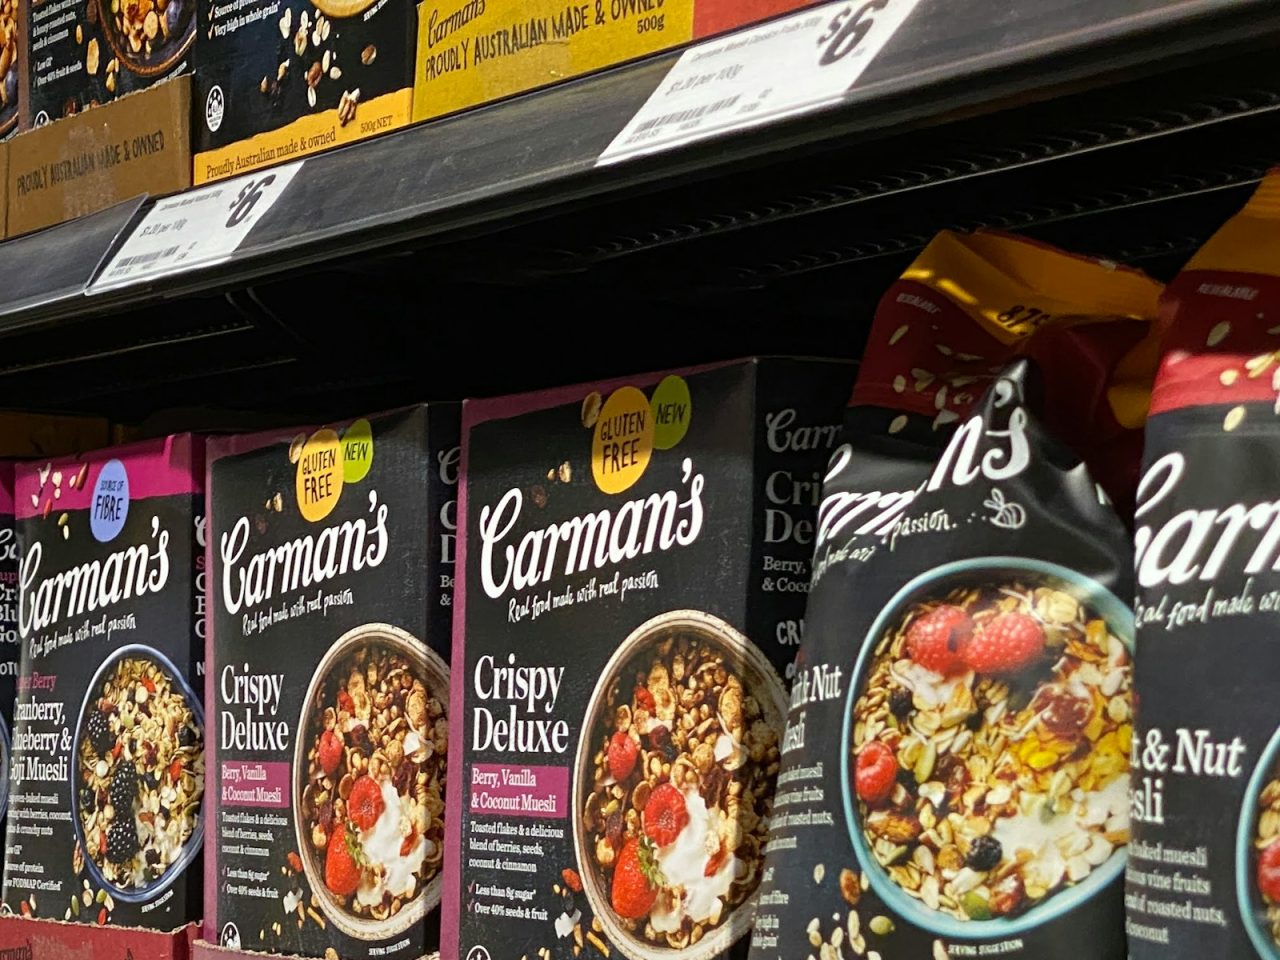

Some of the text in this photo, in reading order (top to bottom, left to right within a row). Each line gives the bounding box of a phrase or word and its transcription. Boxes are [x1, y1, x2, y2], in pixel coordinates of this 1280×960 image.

[426, 36, 470, 81] PROUDLY
[474, 19, 547, 67] AUSTRALIAN
[552, 7, 589, 38] MADE
[595, 3, 607, 26] &
[636, 14, 665, 35] 500g
[360, 115, 393, 134] 500g NET
[206, 127, 336, 179] Proudly Australian made & owned
[600, 411, 645, 442] GLUTEN
[655, 403, 686, 426] NEW
[301, 449, 336, 476] GLUTEN
[344, 442, 368, 461] NEW
[602, 438, 640, 476] FREE
[304, 475, 333, 504] FREE
[480, 457, 704, 599] Carman's
[220, 489, 389, 616] Carman's
[18, 516, 169, 638] Carman's
[508, 569, 658, 623] Real food made with real passion
[220, 662, 285, 716] Crispy
[474, 653, 565, 713] Crispy
[220, 707, 289, 752] Deluxe
[472, 705, 569, 753] Deluxe
[222, 764, 267, 782] Berry, Vanilla
[1142, 728, 1246, 778] & Nut
[472, 767, 536, 788] Berry, Vanilla
[471, 793, 557, 813] & Coconut Muesli
